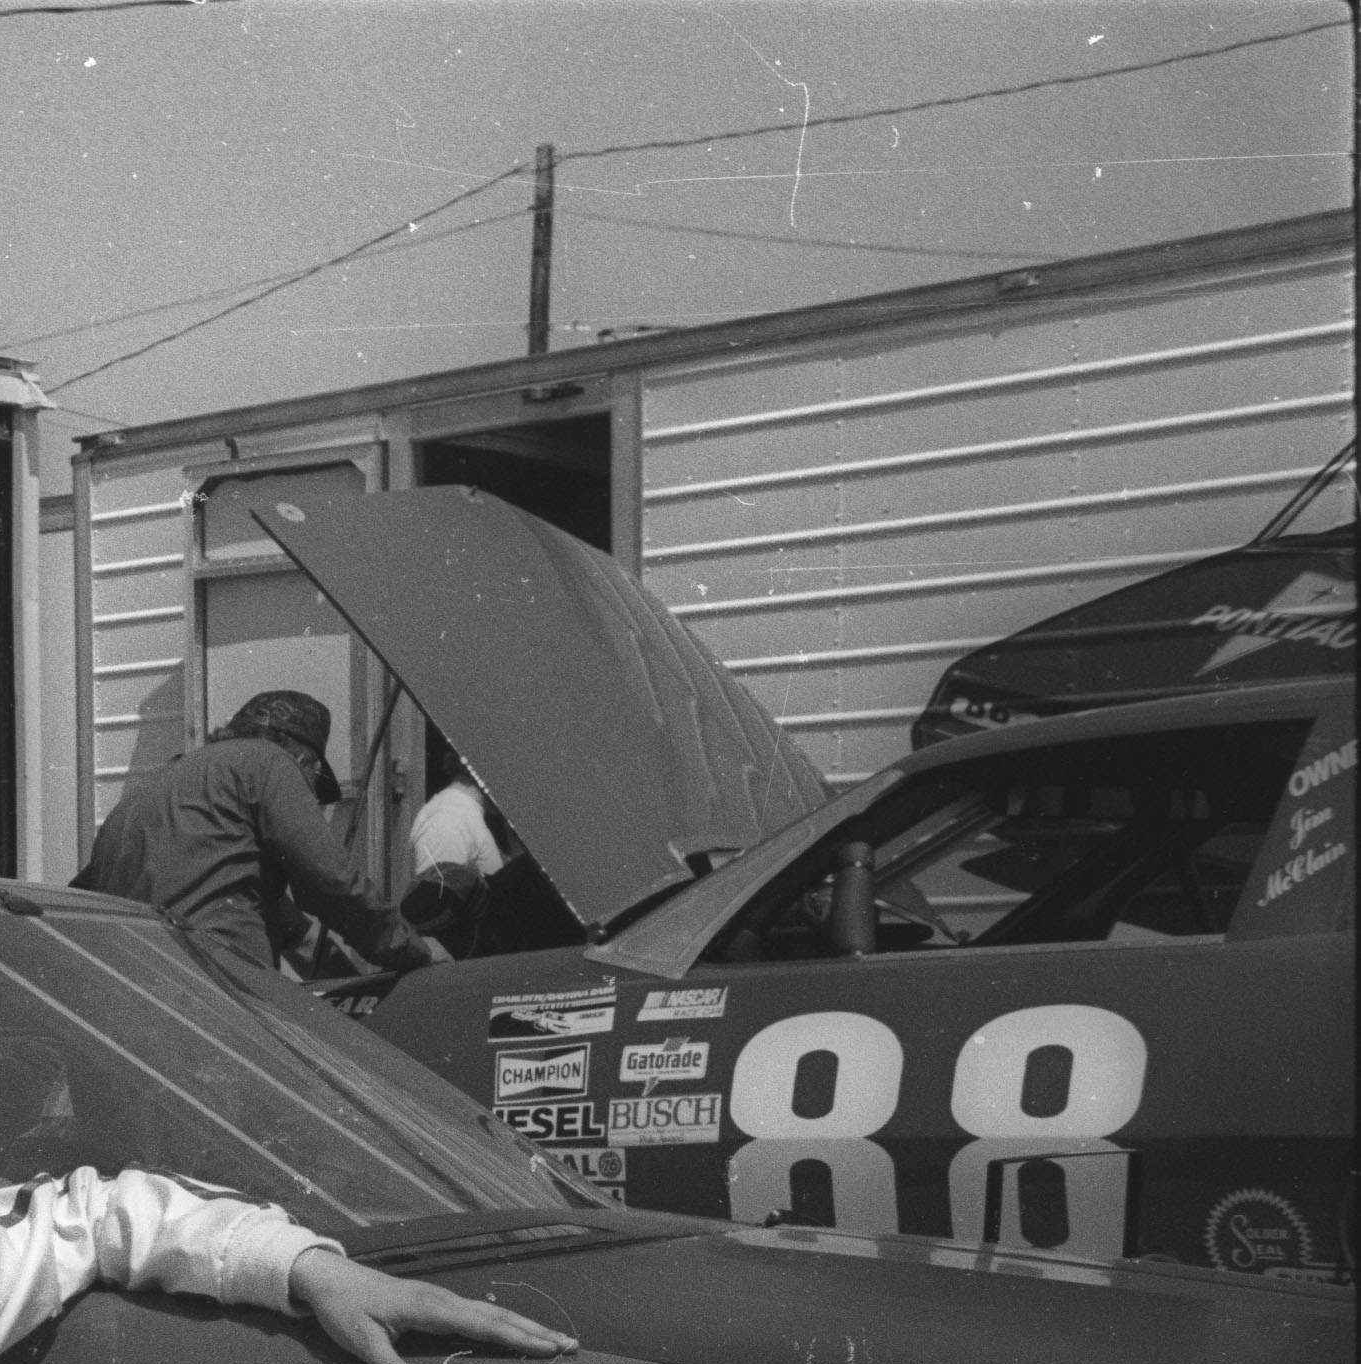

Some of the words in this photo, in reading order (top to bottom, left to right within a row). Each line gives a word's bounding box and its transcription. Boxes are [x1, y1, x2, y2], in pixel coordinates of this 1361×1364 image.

[1290, 806, 1333, 849] Jim
[502, 1061, 582, 1085] CHAMPION
[627, 1049, 703, 1071] Gatorade
[611, 1097, 718, 1130] BUSCH
[729, 1004, 1148, 1258] 88
